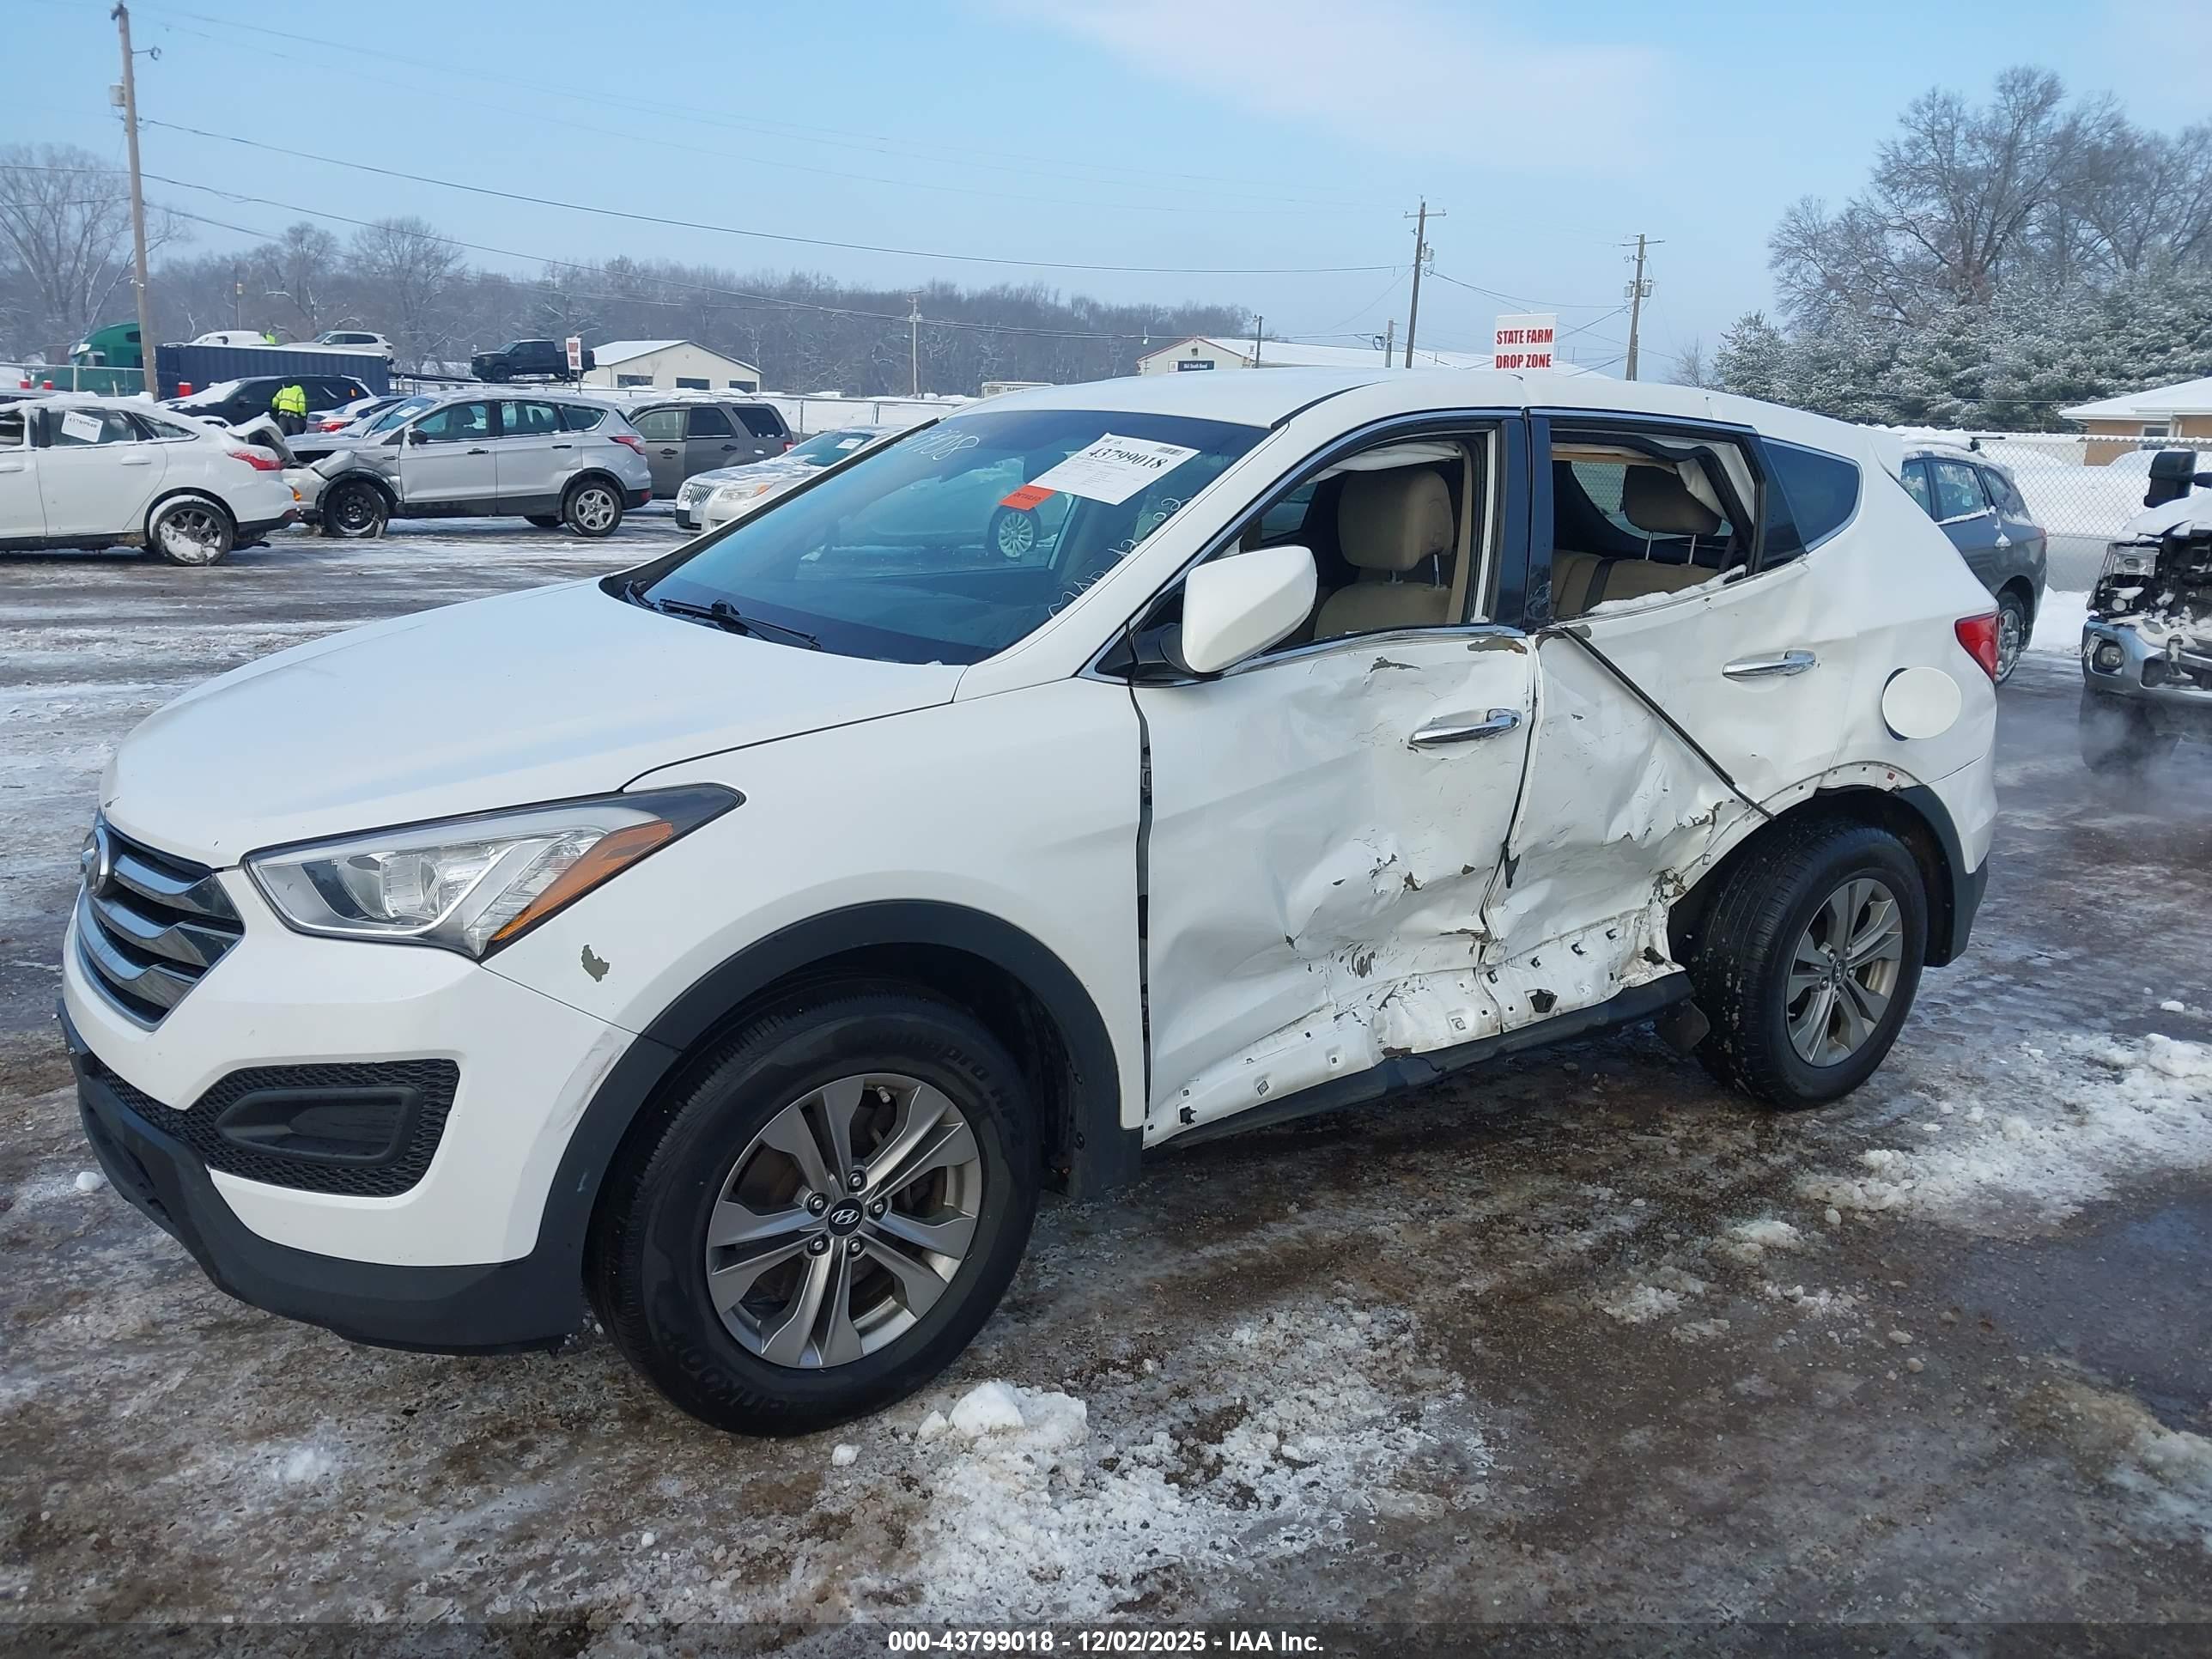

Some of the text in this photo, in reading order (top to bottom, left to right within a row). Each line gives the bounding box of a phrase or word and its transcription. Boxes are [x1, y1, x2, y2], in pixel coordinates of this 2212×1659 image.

[1497, 328, 1553, 345] STATE FARM
[1496, 354, 1552, 369] DROP ZONE
[1089, 447, 1169, 470] 43799018
